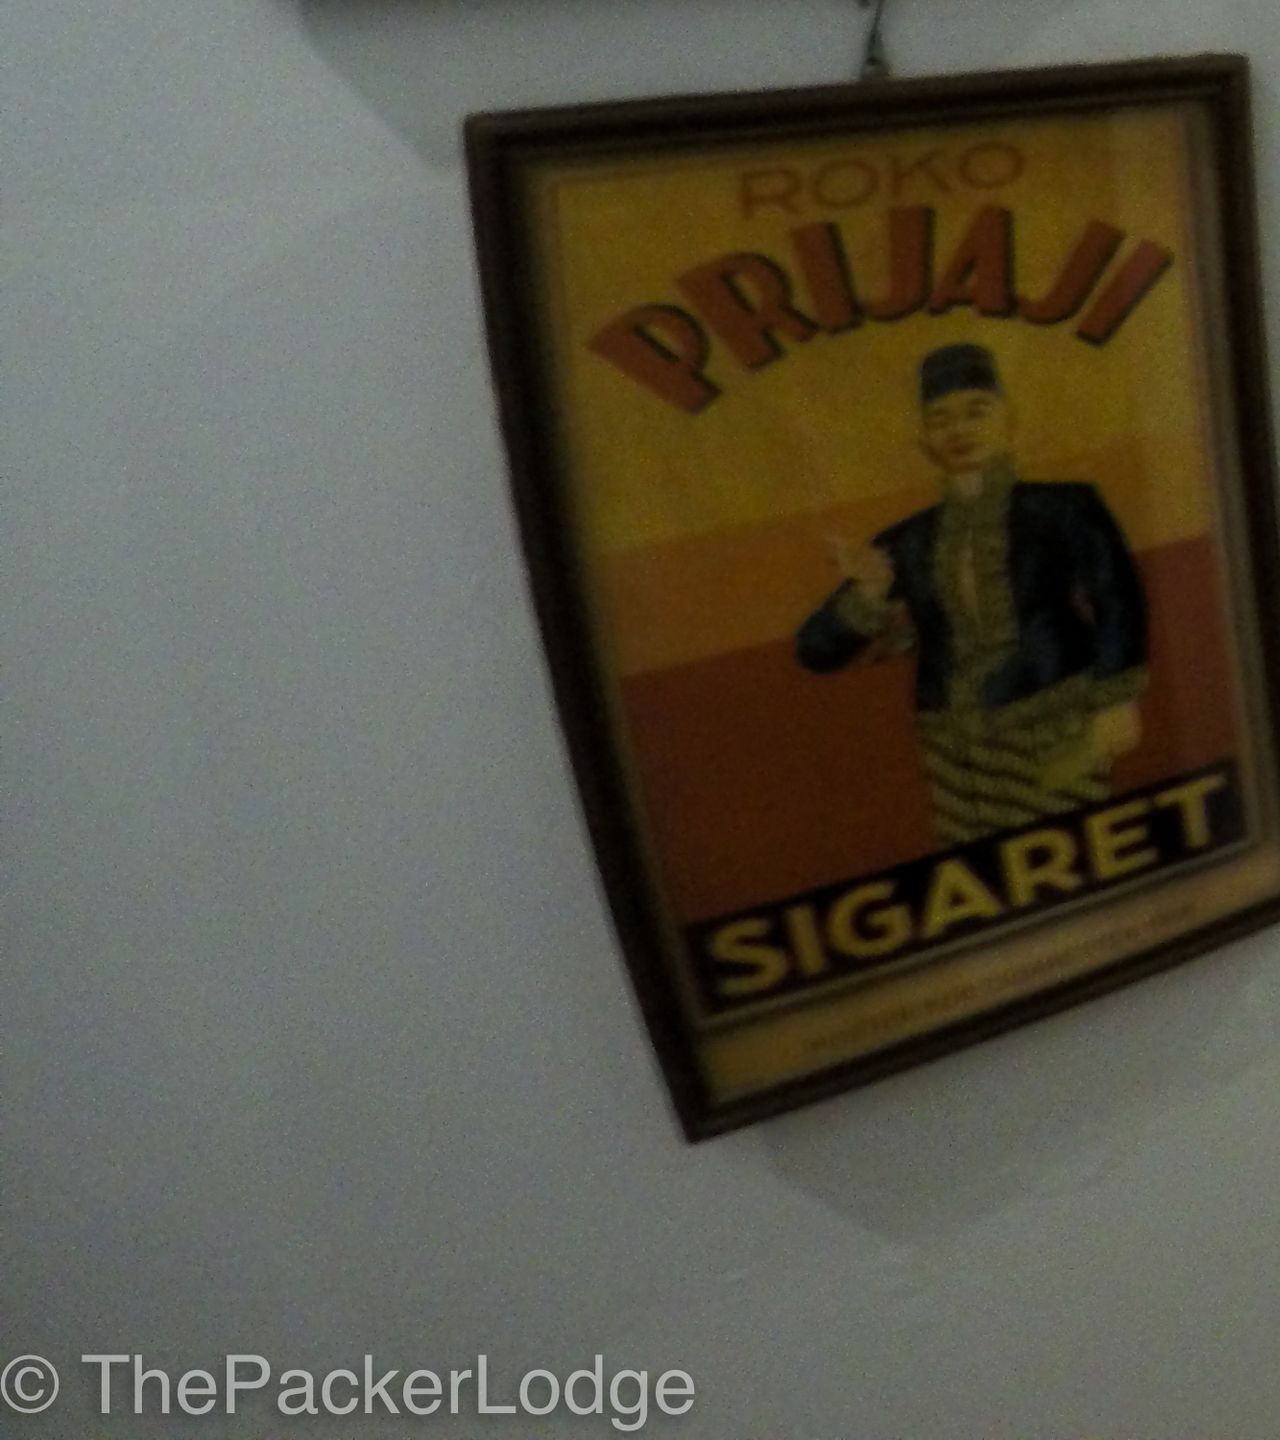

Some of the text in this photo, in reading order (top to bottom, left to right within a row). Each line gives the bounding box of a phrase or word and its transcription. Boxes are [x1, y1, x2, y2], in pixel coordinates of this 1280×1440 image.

[735, 141, 1024, 224] ROKO
[587, 205, 1173, 415] PRIJAJI
[709, 774, 1230, 1000] SIGARET
